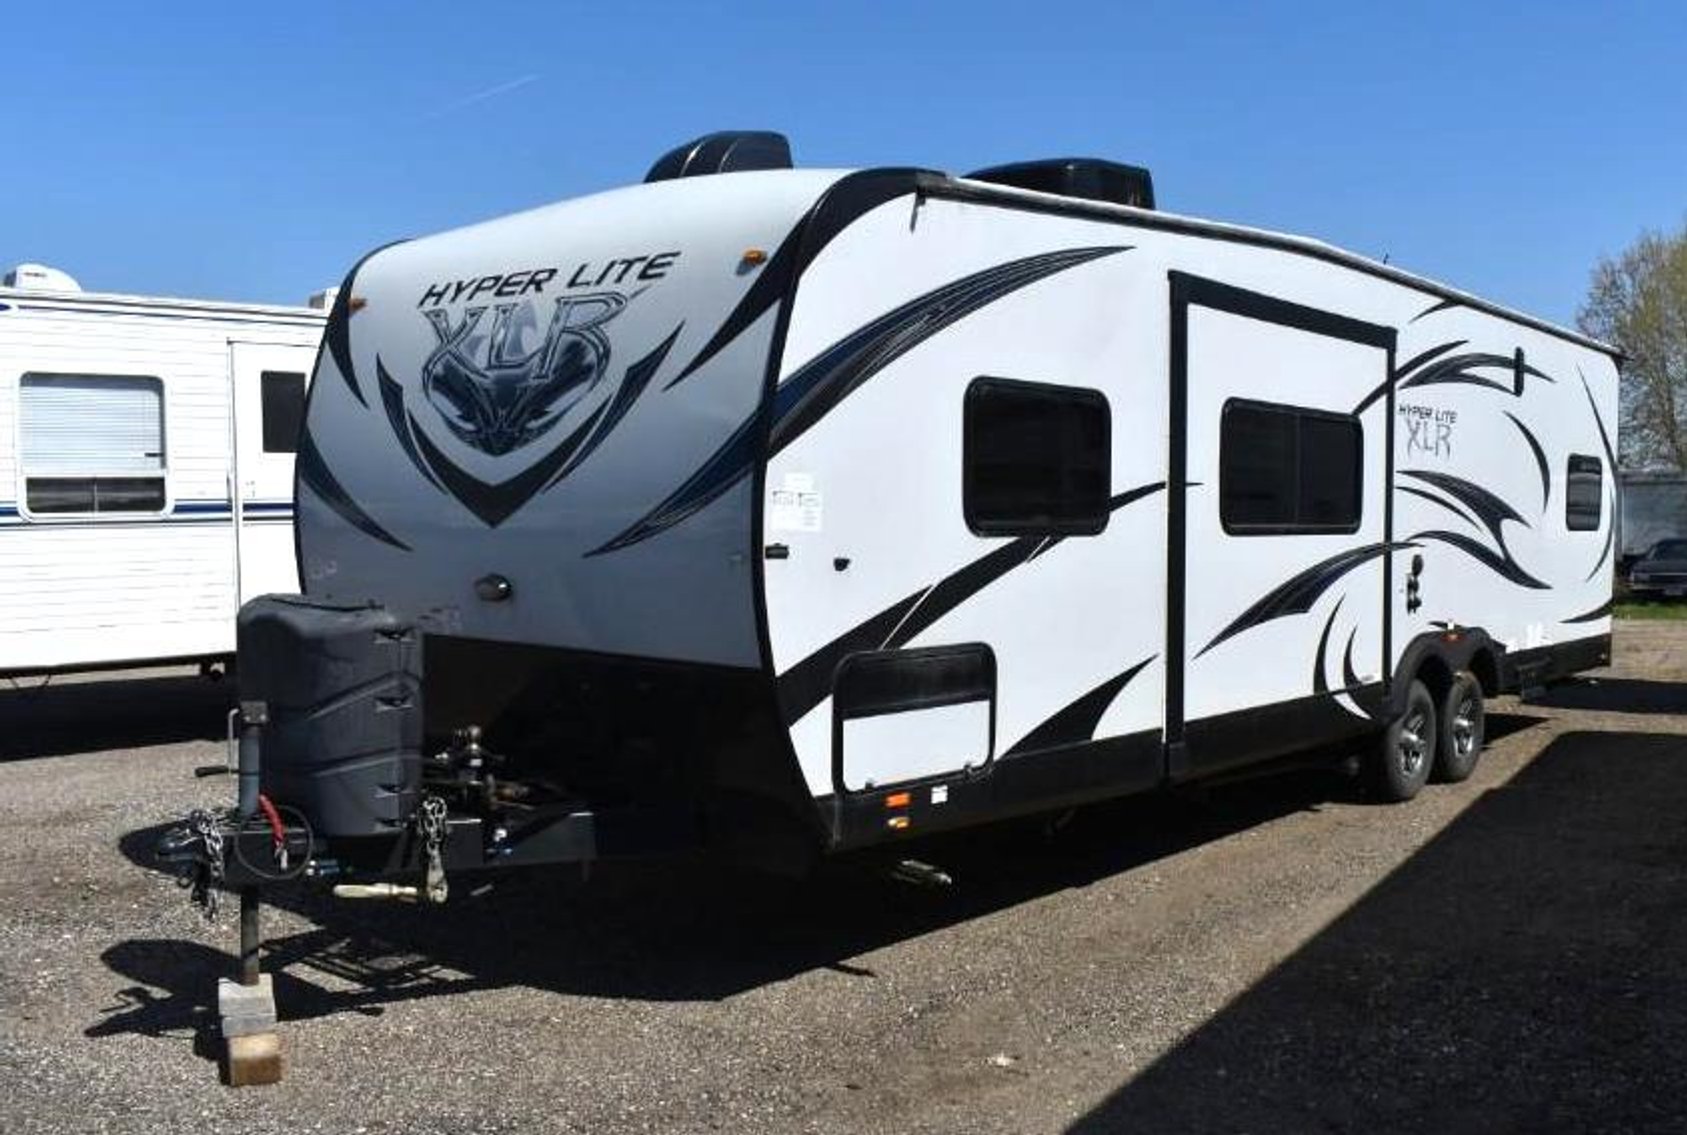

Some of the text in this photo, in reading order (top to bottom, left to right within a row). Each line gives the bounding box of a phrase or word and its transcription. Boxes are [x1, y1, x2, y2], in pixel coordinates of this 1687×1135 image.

[416, 250, 682, 310] HYPER LITE
[421, 292, 628, 396] XLR
[1398, 403, 1457, 424] HYPER LITE
[1405, 418, 1451, 459] XLR
